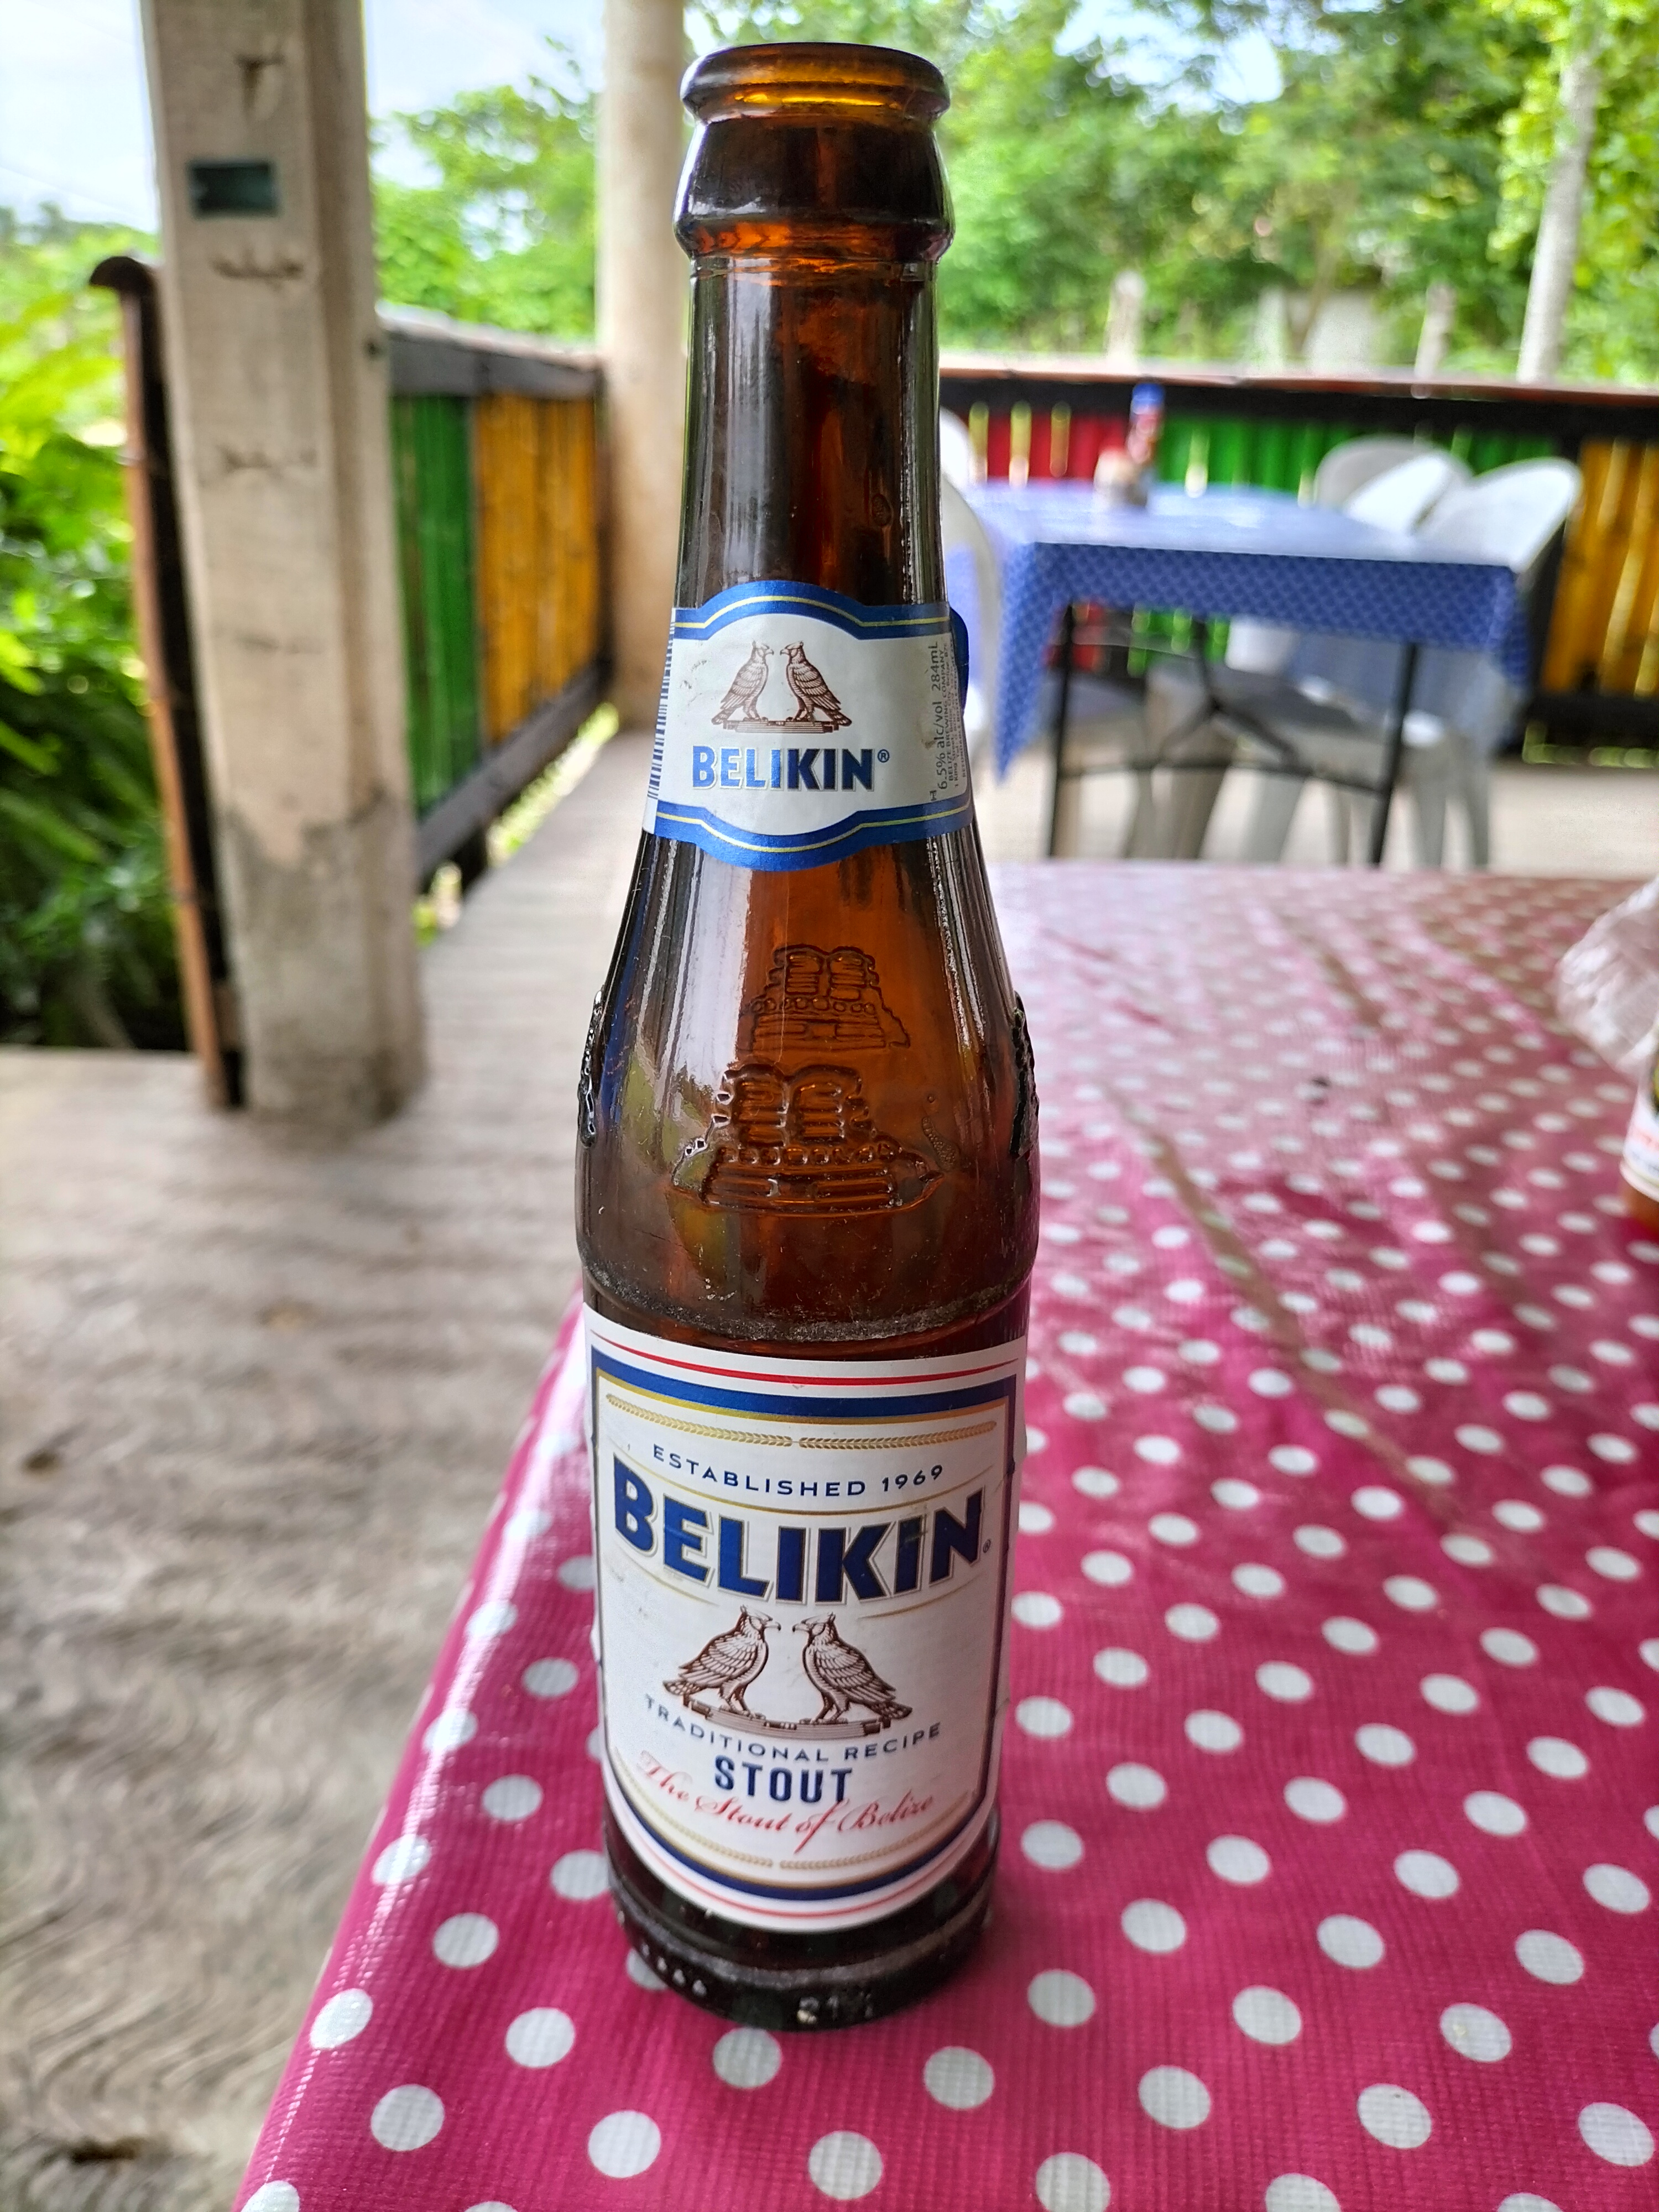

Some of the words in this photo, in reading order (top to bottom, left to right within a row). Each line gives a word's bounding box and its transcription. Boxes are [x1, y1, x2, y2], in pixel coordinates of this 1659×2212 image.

[928, 641, 941, 691] 284mL
[932, 701, 945, 748] alc/vol
[936, 753, 948, 790] 6.5%
[654, 1444, 865, 1496] ESTABLISHED
[882, 1464, 942, 1491] 1969
[645, 1693, 828, 1761] TRADITIONAL
[844, 1721, 940, 1761] RECIPE
[640, 1750, 693, 1801] The
[695, 1796, 792, 1831] Stout
[794, 1798, 850, 1854] of
[837, 1790, 932, 1832] Belize
[715, 1754, 852, 1802] STOUT
